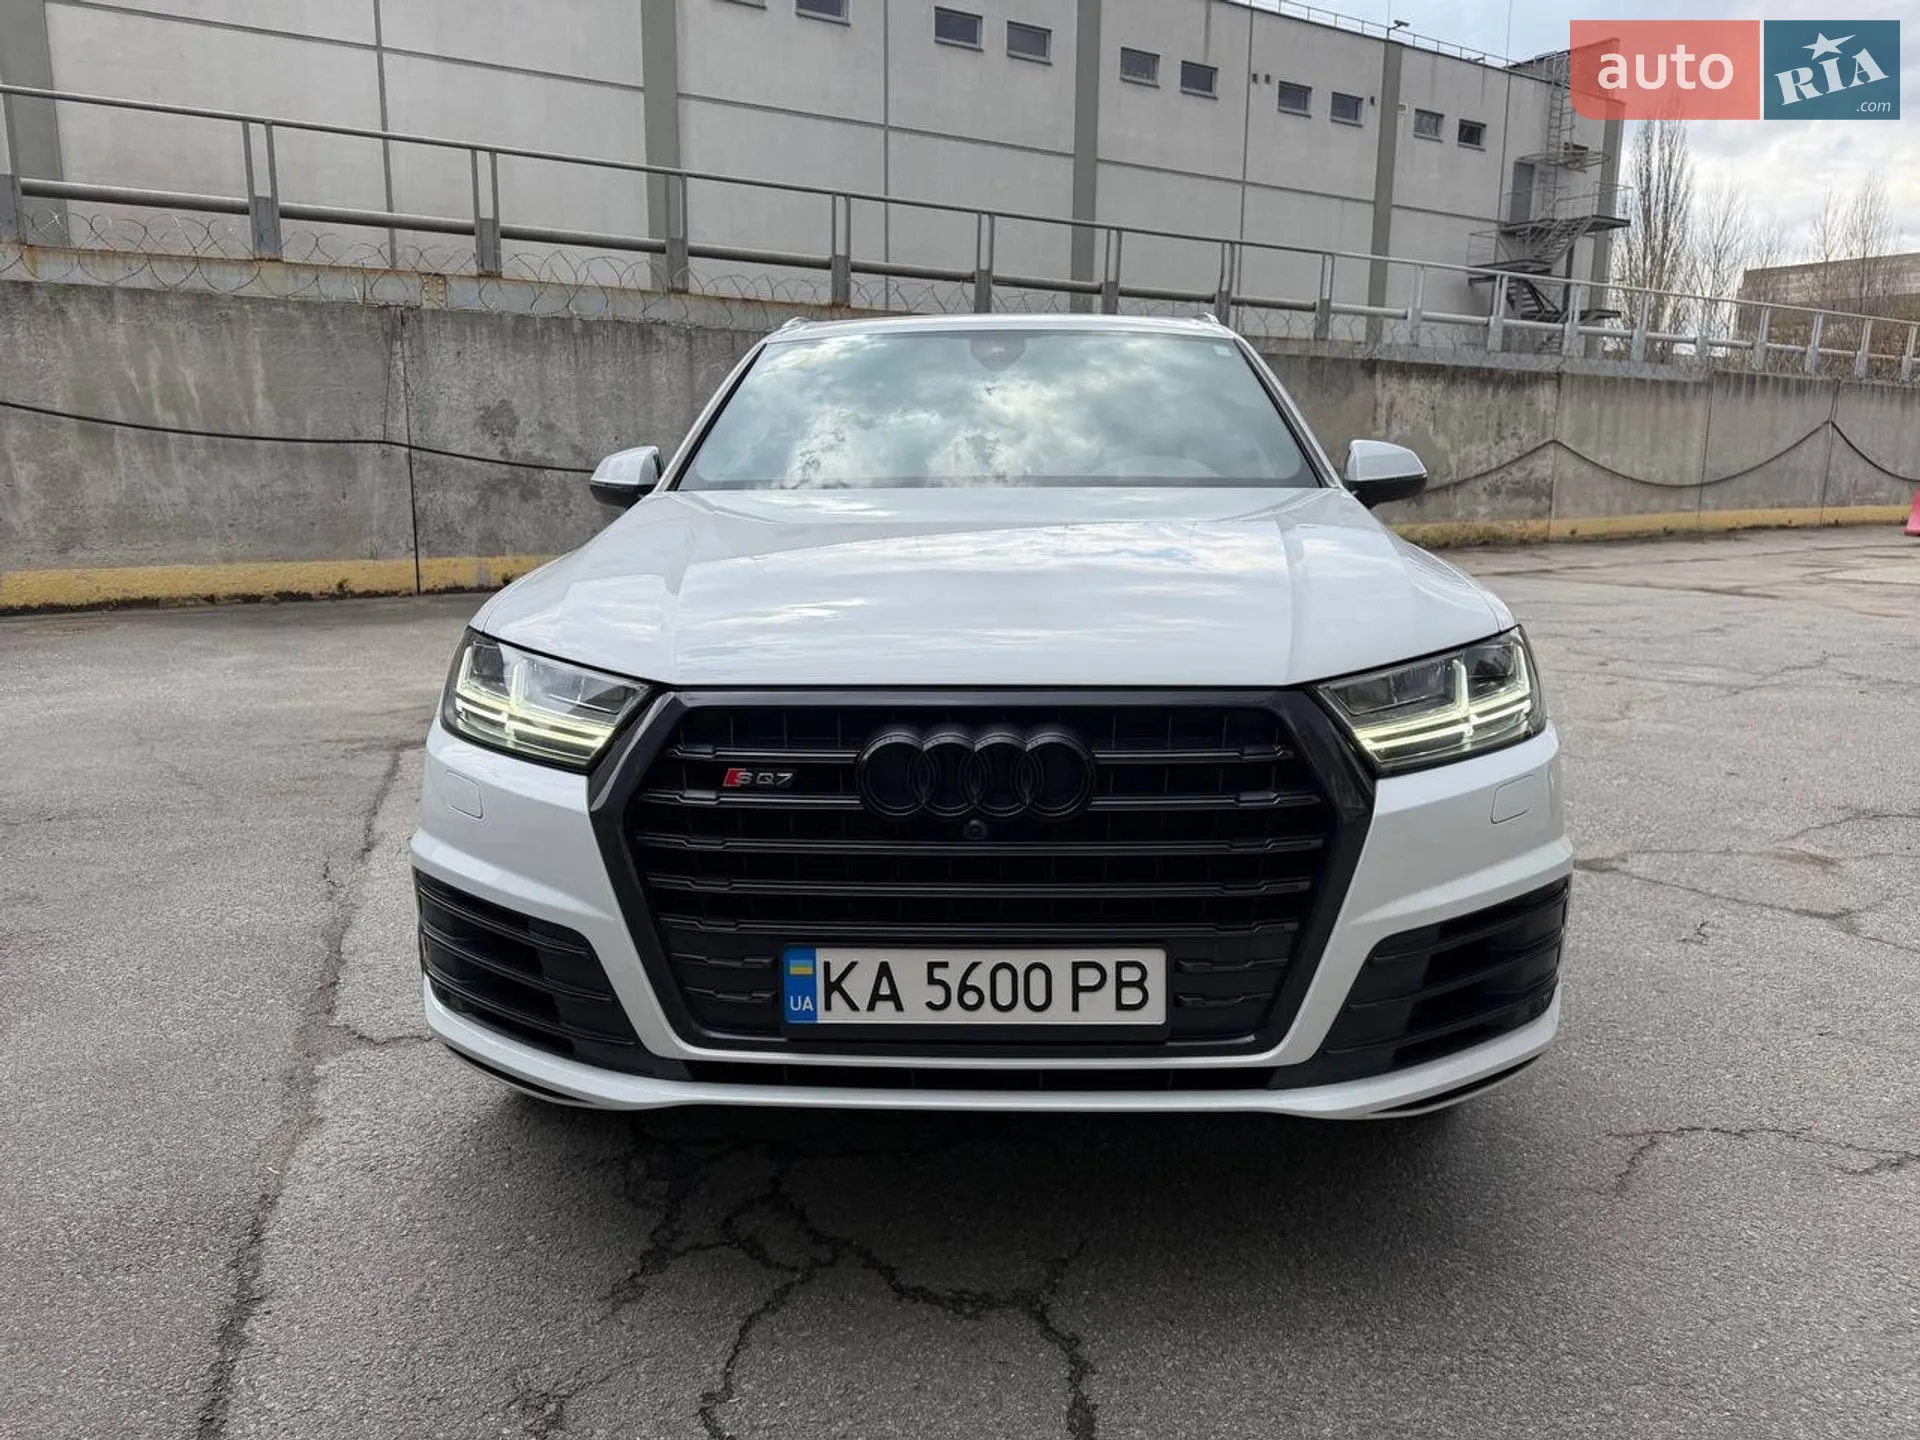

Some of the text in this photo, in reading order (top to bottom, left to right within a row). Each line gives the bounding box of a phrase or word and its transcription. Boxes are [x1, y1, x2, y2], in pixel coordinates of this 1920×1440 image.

[790, 995, 814, 1011] UA
[823, 961, 1150, 1012] KA 5600 PB
